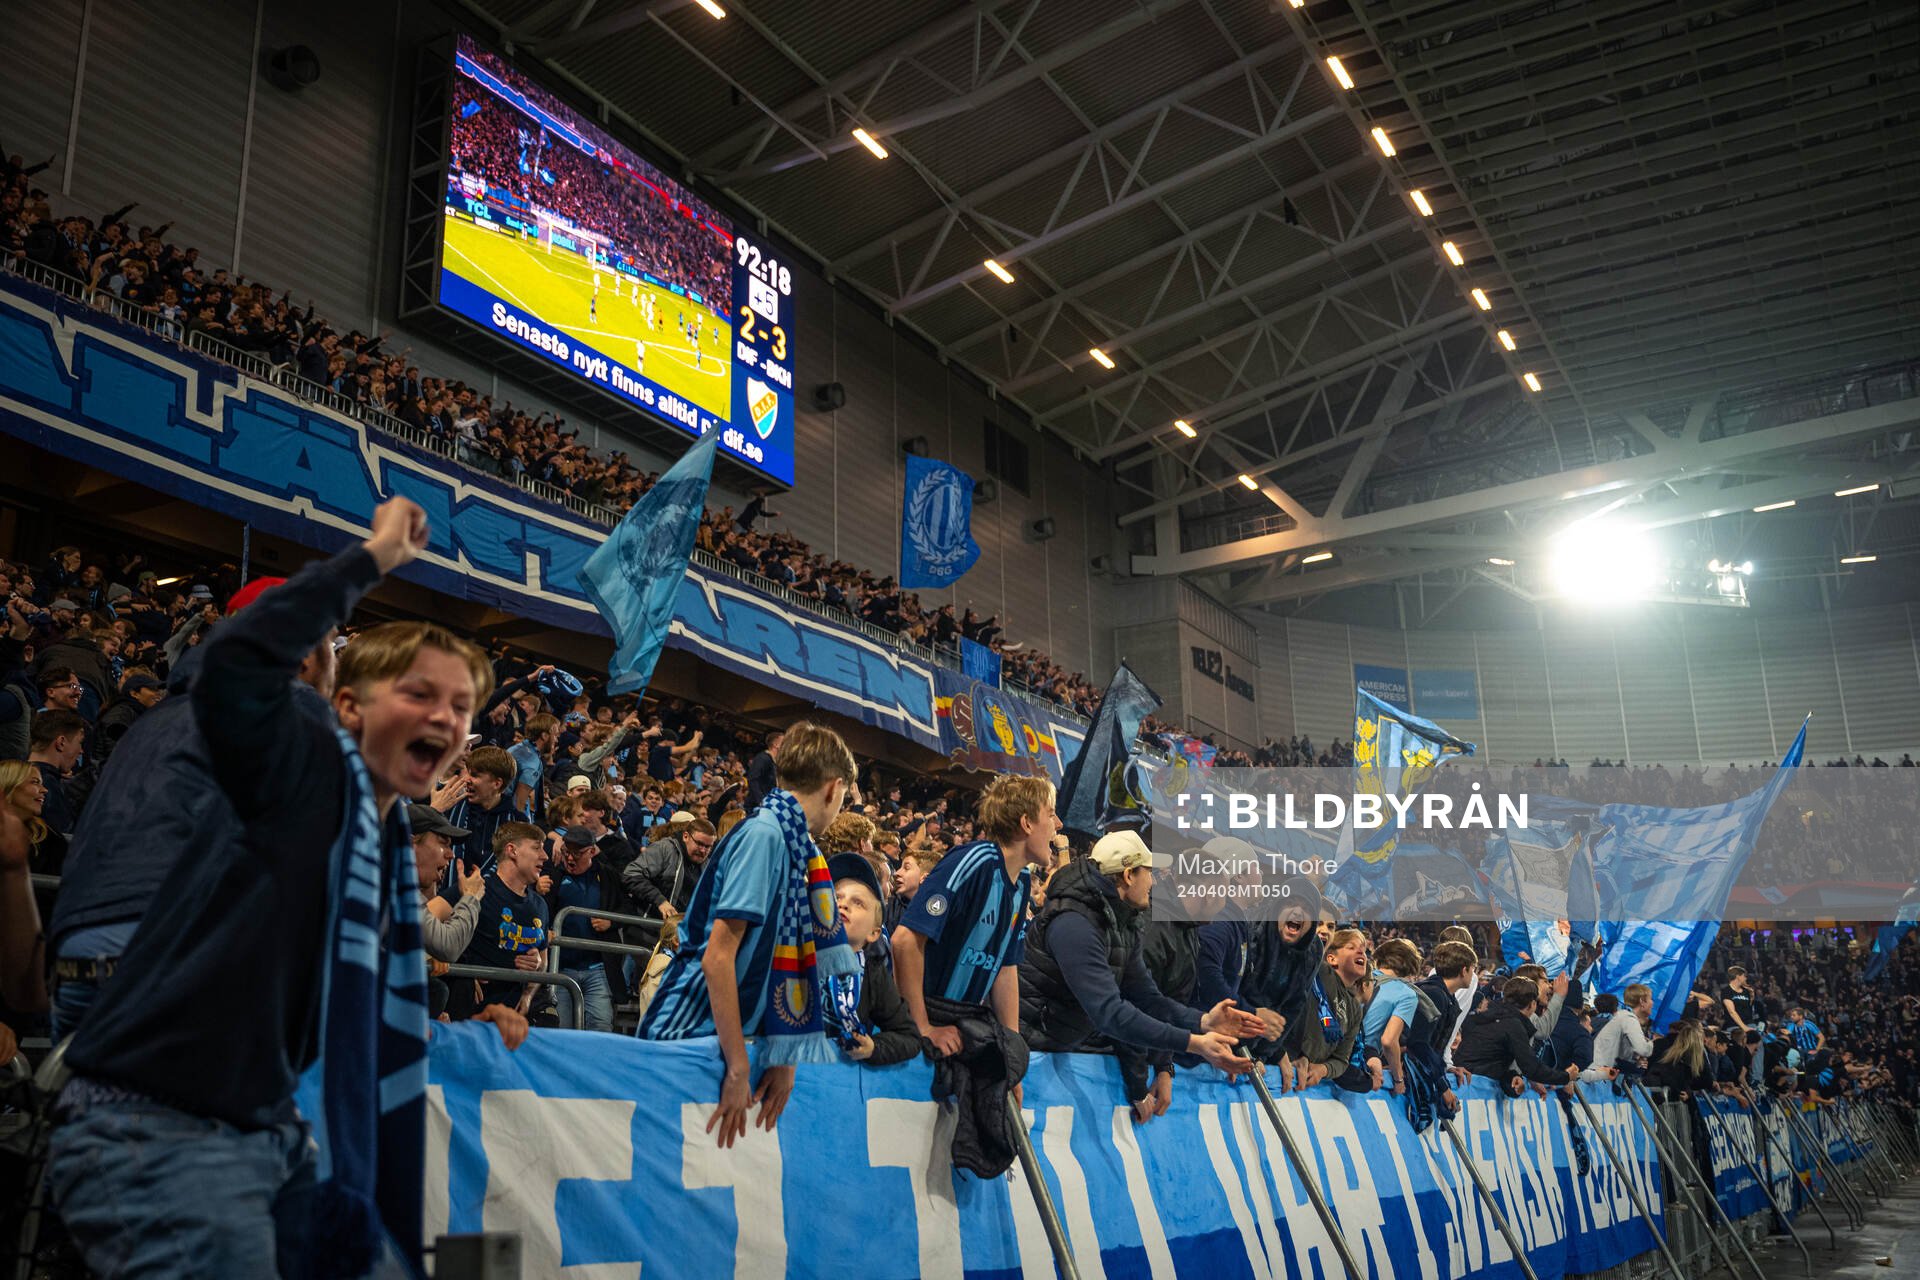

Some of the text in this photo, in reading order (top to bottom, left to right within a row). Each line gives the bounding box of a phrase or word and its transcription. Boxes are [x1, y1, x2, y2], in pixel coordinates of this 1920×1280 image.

[465, 198, 491, 220] TCL
[736, 237, 791, 296] 92:18
[736, 341, 758, 367] DIF
[740, 305, 756, 343] 2
[771, 326, 787, 361] 3
[492, 302, 569, 360] Senaste
[574, 350, 608, 382] nytt
[611, 368, 655, 406] finns
[658, 395, 698, 429] alltid
[723, 428, 764, 464] dif.se
[1360, 681, 1405, 693] AMERICAN
[1198, 1096, 1397, 1280] VAR
[1417, 1098, 1567, 1280] SVENSK
